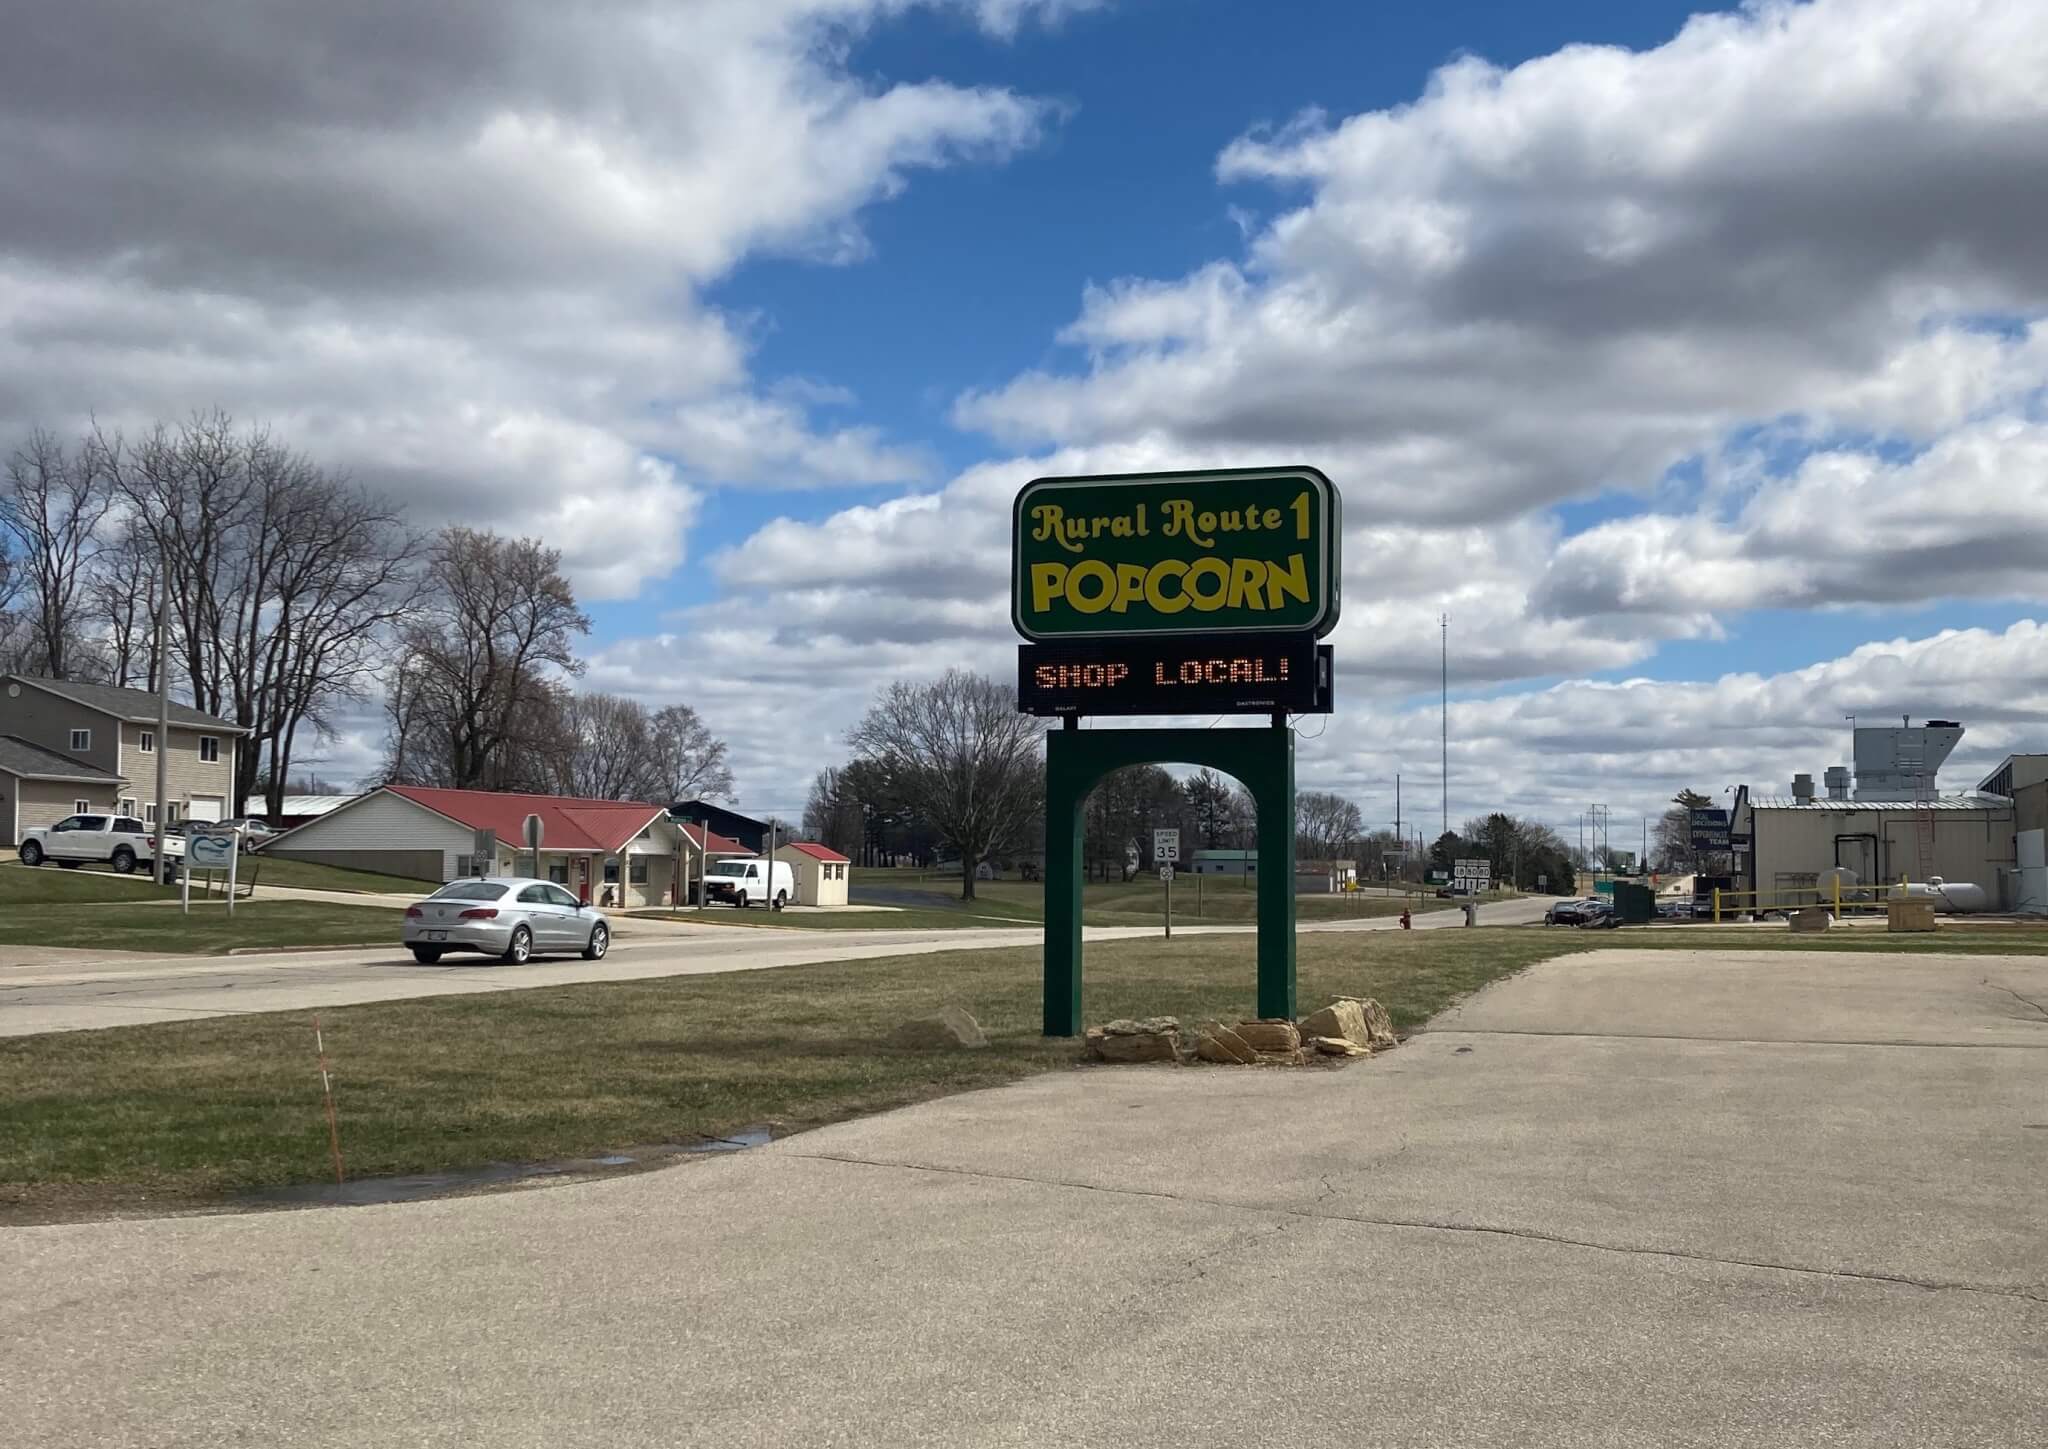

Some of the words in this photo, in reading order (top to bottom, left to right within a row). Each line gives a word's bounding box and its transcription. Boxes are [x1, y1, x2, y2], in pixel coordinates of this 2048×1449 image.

[1032, 504, 1149, 553] Rural
[1161, 499, 1282, 548] Route
[1289, 492, 1310, 540] 1
[1031, 553, 1310, 614] POPCORN
[1036, 662, 1128, 688] SHOP
[1155, 658, 1289, 685] LOCAL!
[1157, 846, 1177, 858] 35
